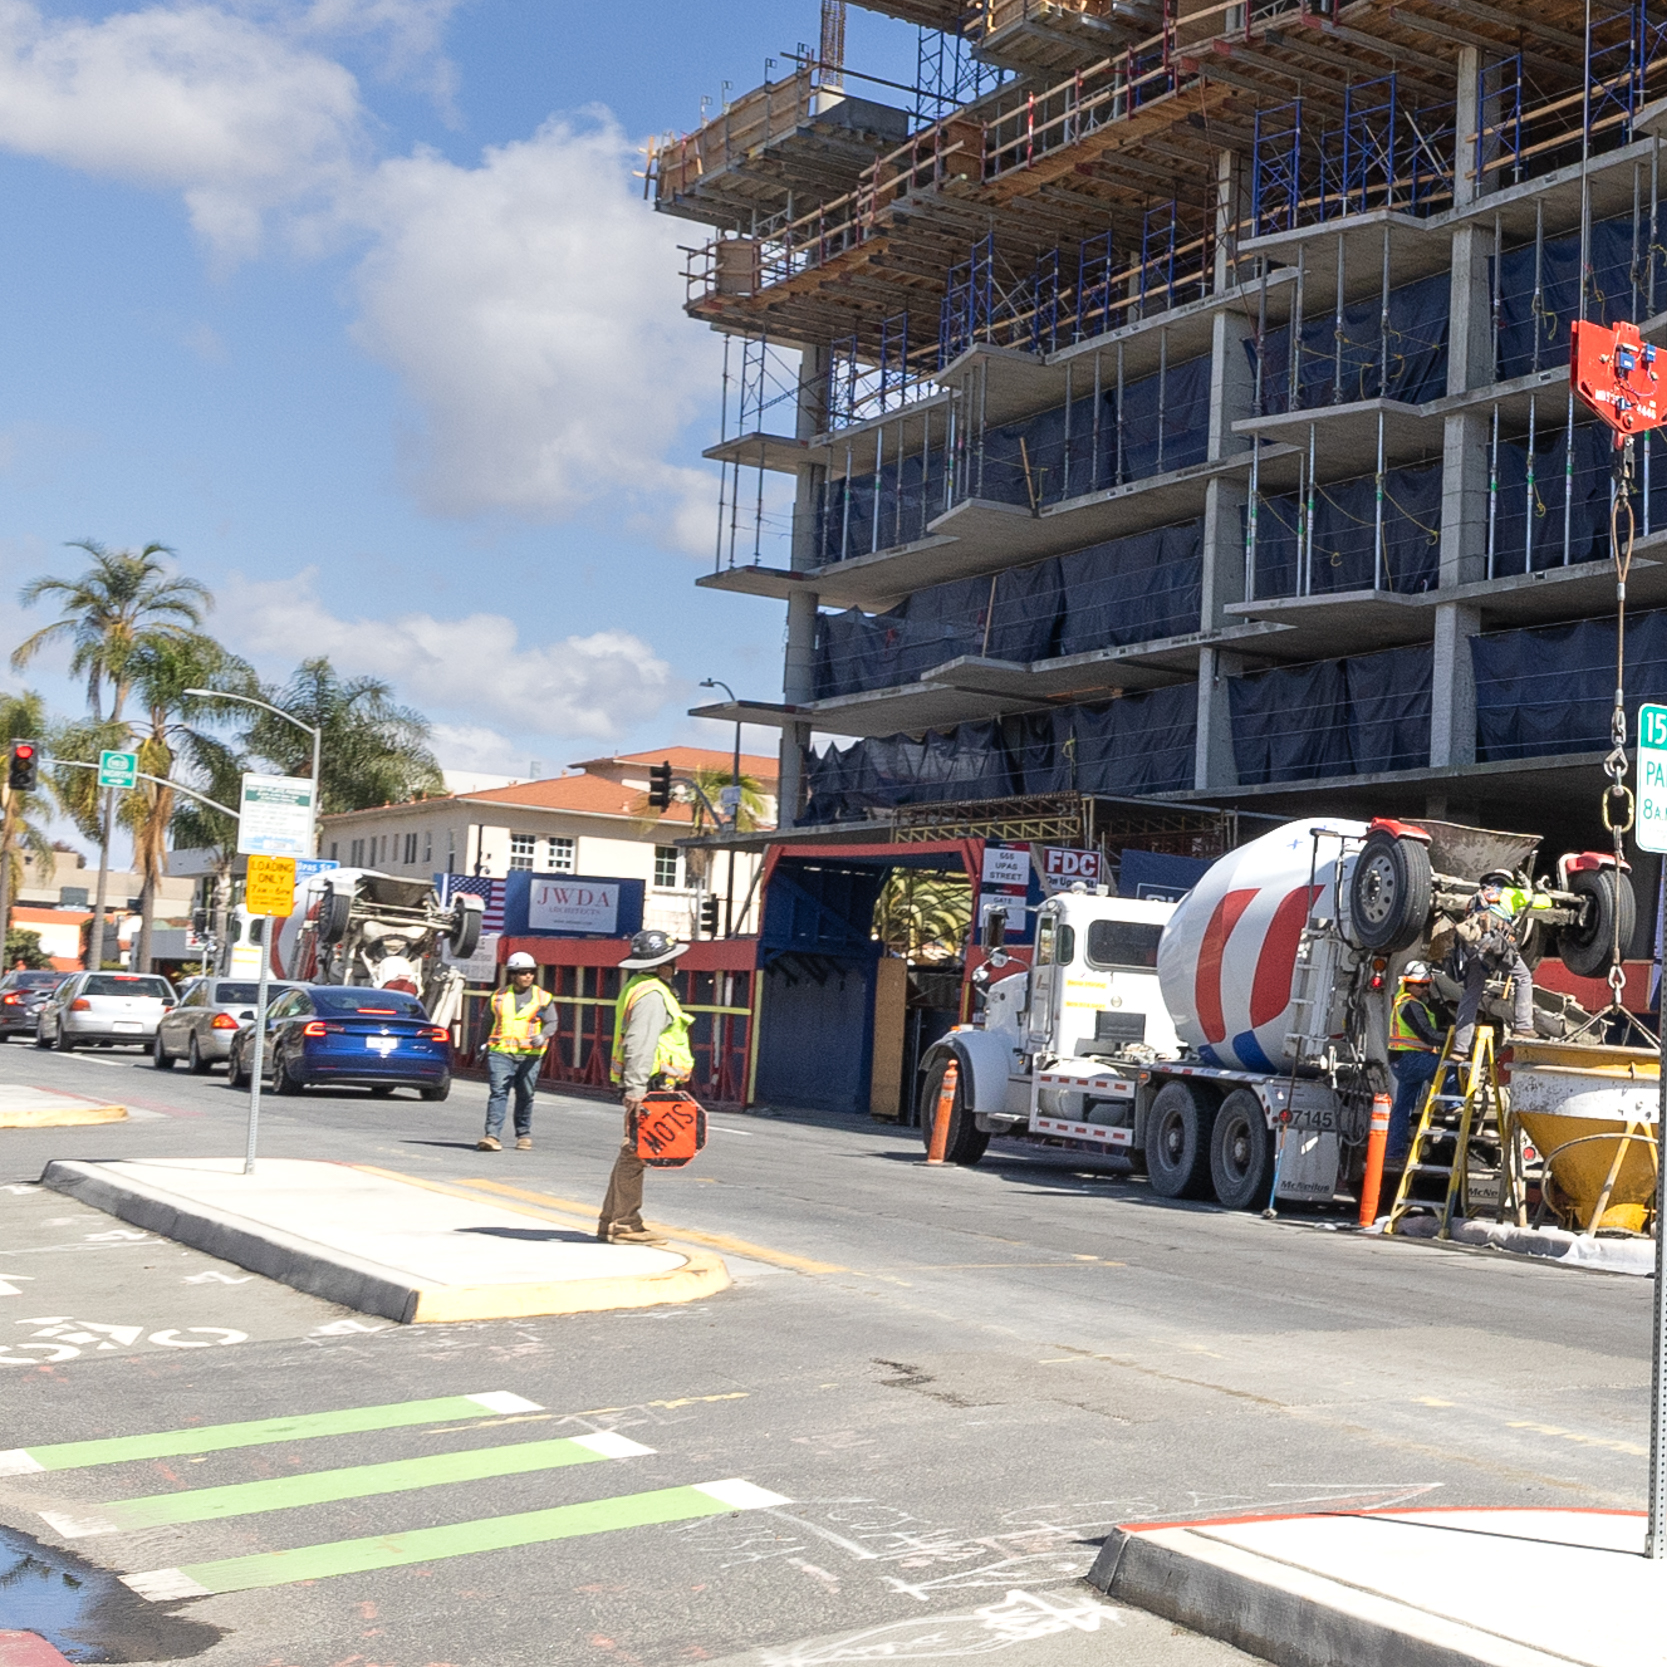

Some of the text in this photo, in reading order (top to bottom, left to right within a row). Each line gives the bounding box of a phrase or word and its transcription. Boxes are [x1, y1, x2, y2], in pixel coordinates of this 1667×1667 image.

[1647, 712, 1667, 745] 15
[251, 861, 294, 873] LOADING
[995, 862, 1018, 870] UPAS
[1047, 850, 1097, 876] FDC
[258, 873, 285, 884] ONLY
[989, 871, 1022, 881] STREET
[537, 886, 610, 907] JWDA
[1292, 1110, 1333, 1128] 7145
[641, 1103, 694, 1155] SLOW
[1281, 1180, 1330, 1193] McNeilus
[1468, 1187, 1499, 1197] McNe
